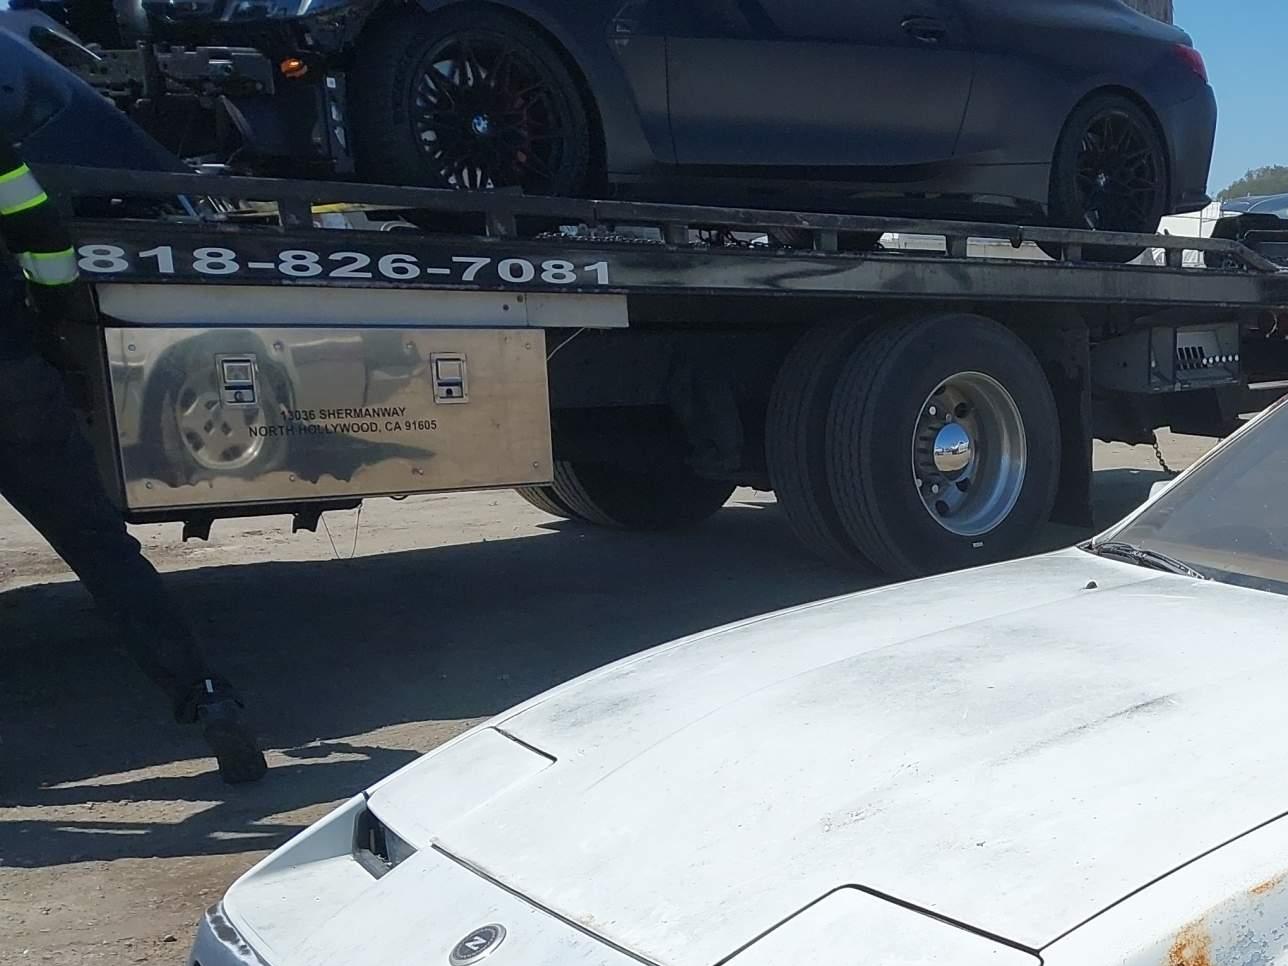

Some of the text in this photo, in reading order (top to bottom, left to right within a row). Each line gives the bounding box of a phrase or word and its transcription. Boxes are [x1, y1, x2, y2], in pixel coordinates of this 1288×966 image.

[77, 244, 609, 285] 818-826-7081
[281, 409, 316, 422] 13036
[249, 424, 295, 438] NORTH
[385, 421, 401, 432] CA
[404, 419, 437, 431] 91605
